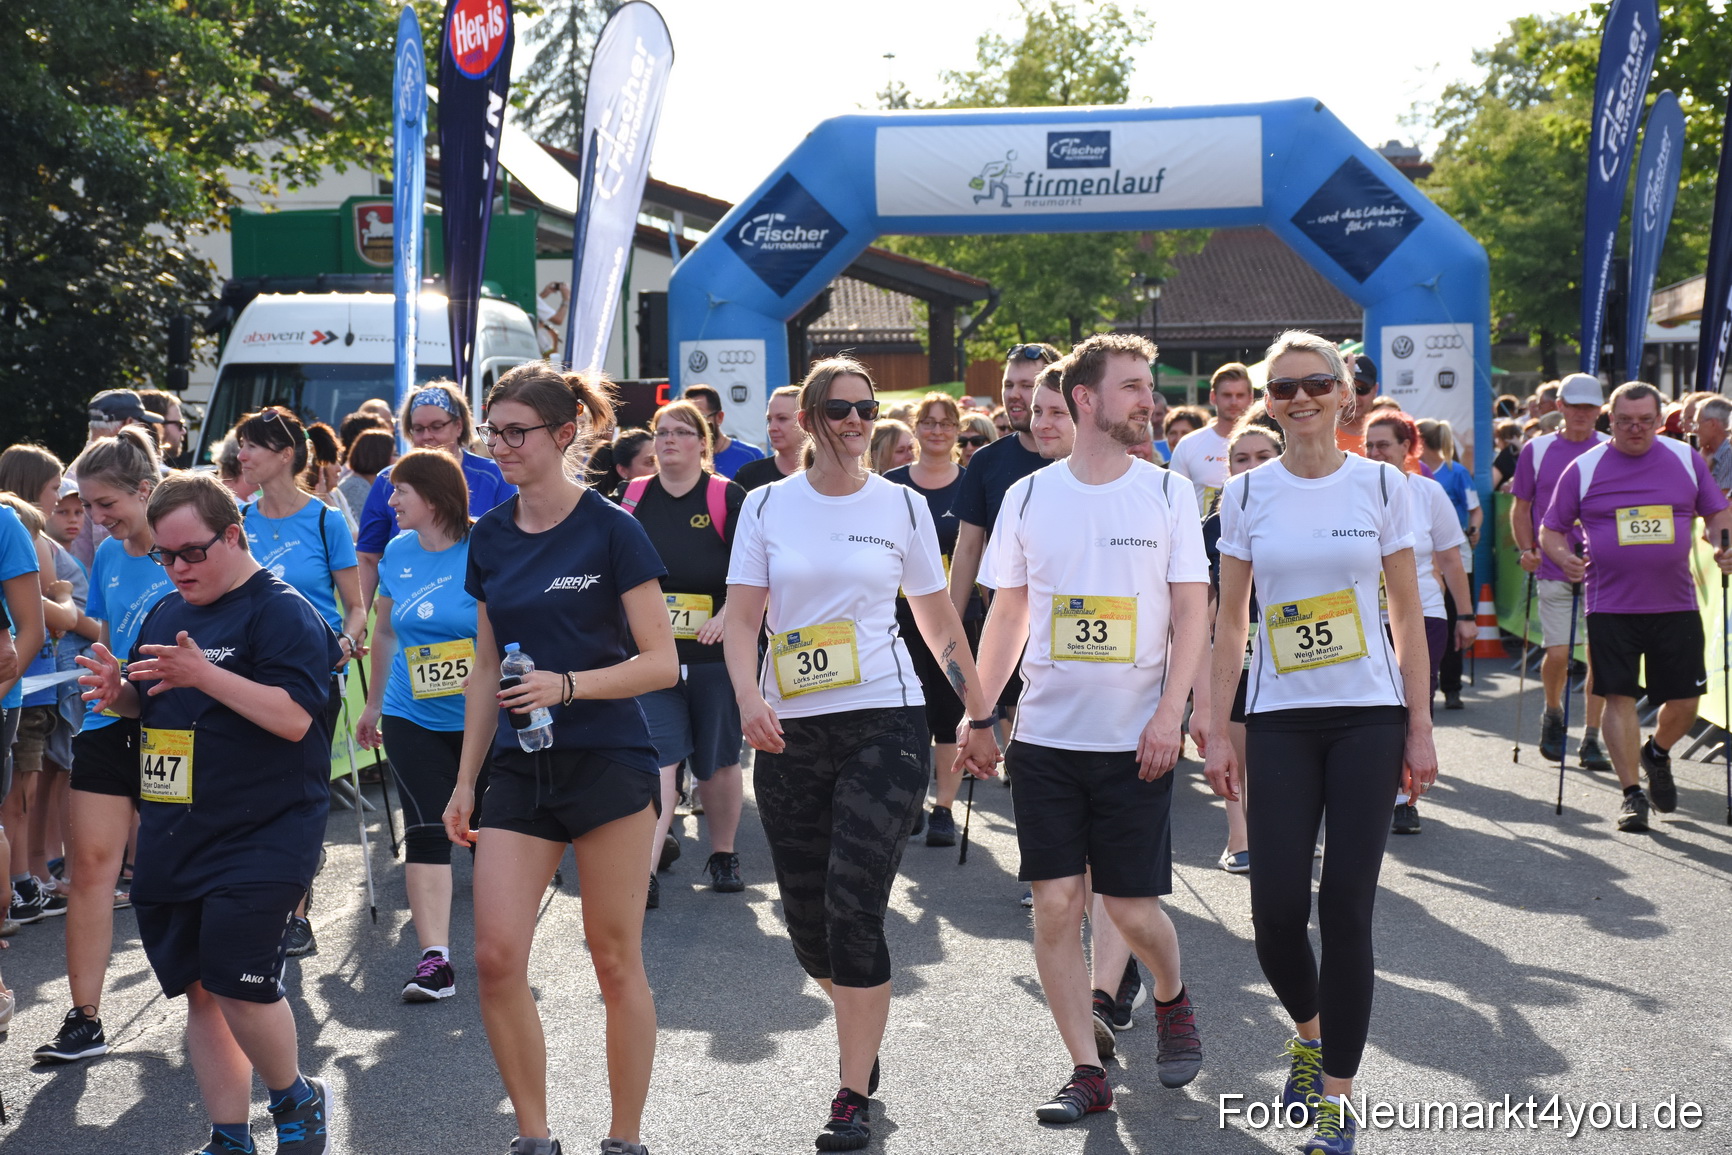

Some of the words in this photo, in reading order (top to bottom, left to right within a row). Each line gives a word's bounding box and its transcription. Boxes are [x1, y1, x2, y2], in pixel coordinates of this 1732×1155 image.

[454, 1, 504, 55] Hervis
[1605, 11, 1642, 153] Fischer
[1620, 29, 1647, 146] AUTOMOBILE
[601, 36, 648, 173] Fischer
[624, 53, 656, 165] AUTOMOBILE
[1058, 142, 1108, 157] Fischer
[1024, 168, 1166, 197] firmenlauf
[1024, 198, 1082, 208] neumarkt
[754, 223, 830, 242] Fischer
[760, 241, 823, 250] AUTOMOBILE
[243, 331, 306, 342] abavent
[1331, 528, 1376, 538] auctores
[1630, 520, 1662, 534] 632
[848, 533, 895, 550] auctores
[1110, 536, 1157, 549] auctores
[544, 576, 584, 593] JURA
[395, 599, 411, 616] Team
[411, 582, 436, 599] Schick
[437, 574, 452, 584] Bau
[116, 611, 132, 633] Team
[130, 589, 151, 610] Schick
[151, 579, 168, 590] Bau
[1335, 608, 1353, 617] 2019
[1075, 619, 1108, 643] 33
[1296, 621, 1333, 650] 35
[1086, 643, 1117, 651] Christian
[1245, 639, 1254, 656] 4
[1294, 650, 1315, 660] Weigl
[1316, 644, 1343, 655] Martina
[797, 648, 828, 675] 30
[1323, 652, 1339, 660] GmbH
[416, 658, 469, 684] 1525
[812, 671, 838, 680] Jennifer
[429, 681, 441, 689] Fink
[441, 680, 458, 689] Birgit
[240, 973, 265, 983] JAKO
